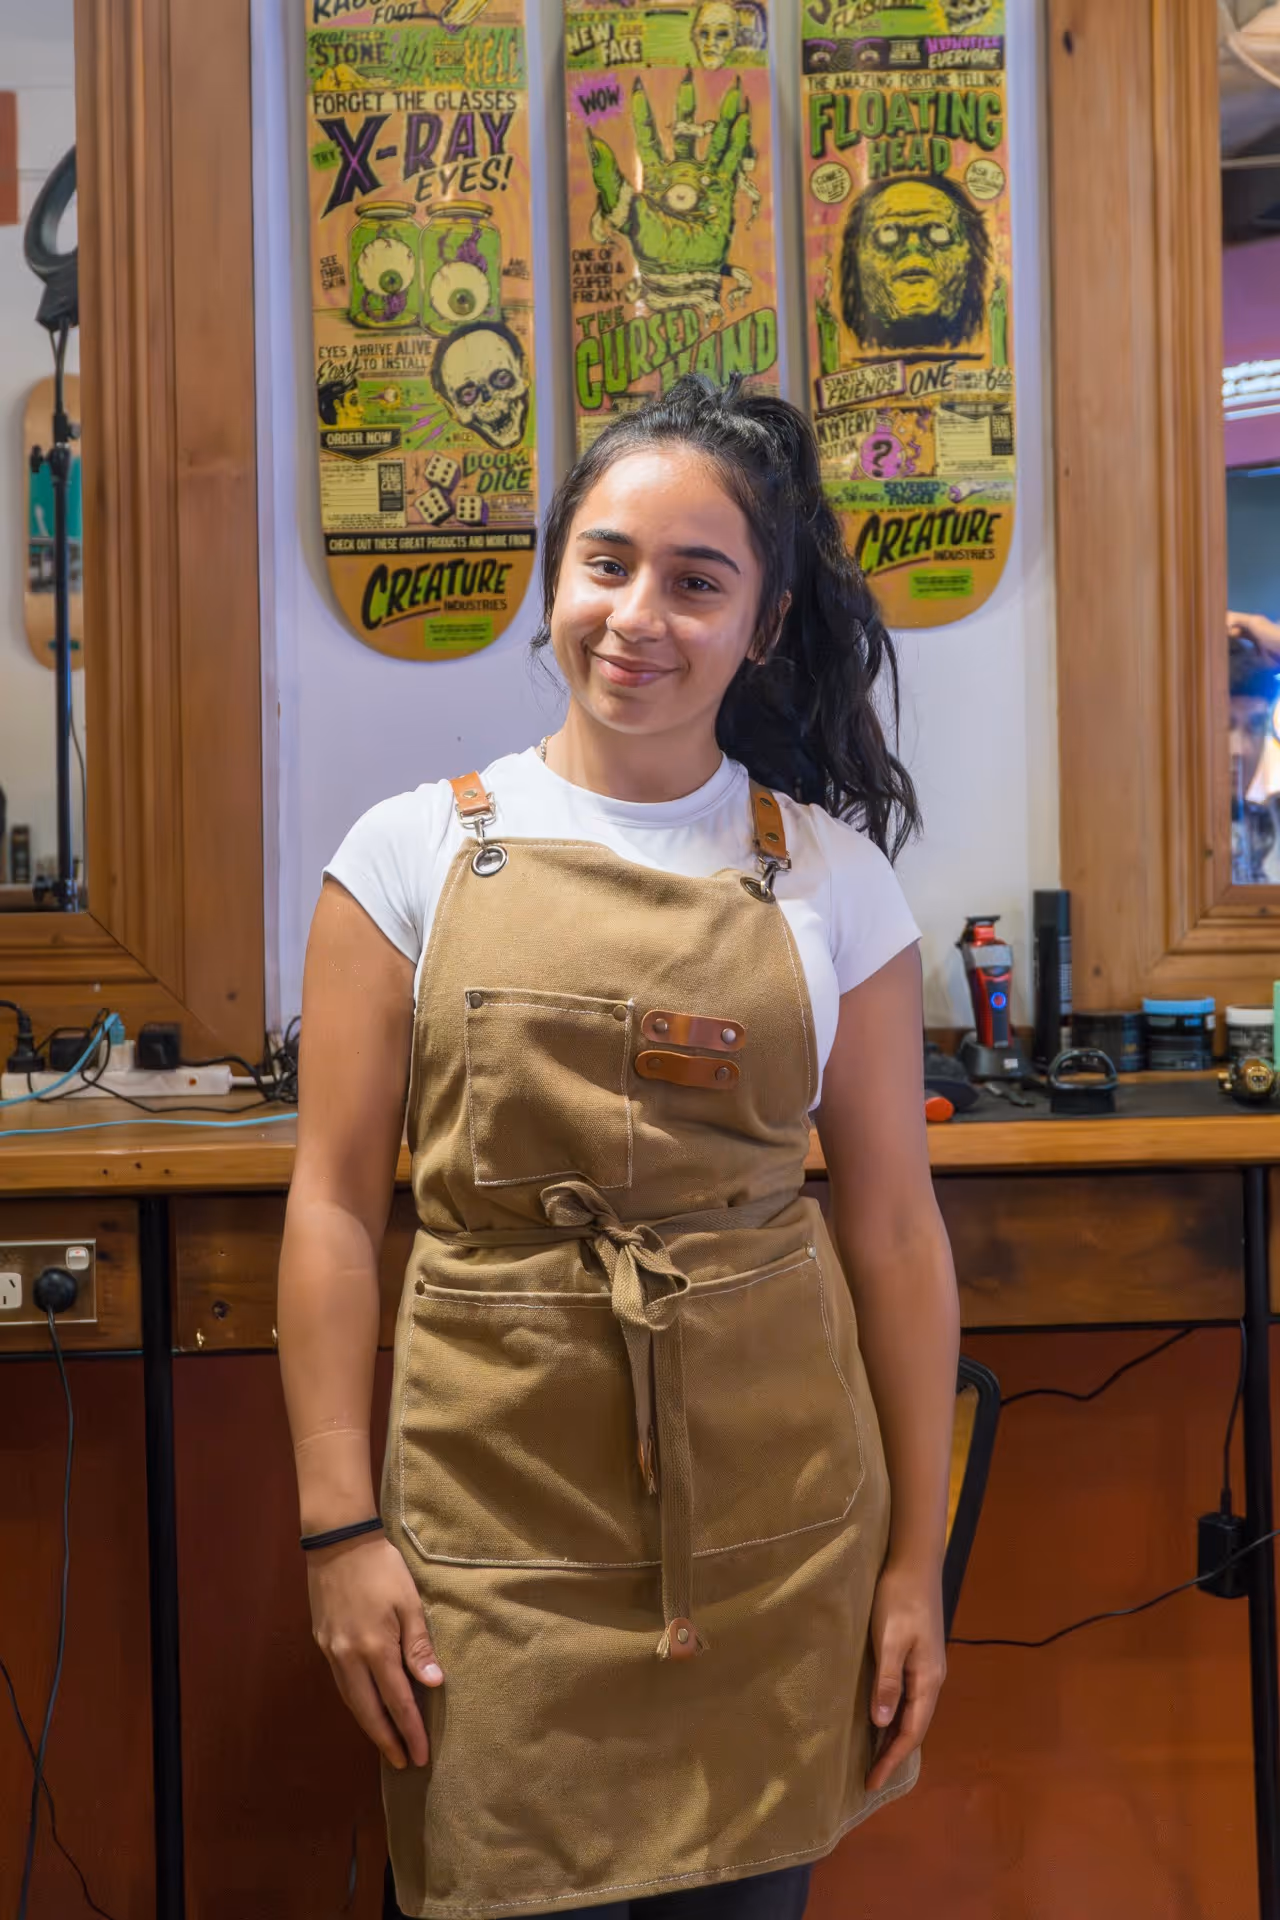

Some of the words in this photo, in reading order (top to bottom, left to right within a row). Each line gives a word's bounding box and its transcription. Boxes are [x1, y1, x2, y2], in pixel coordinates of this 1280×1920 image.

[372, 1, 418, 24] FOOT
[566, 22, 613, 55] NEW
[601, 38, 642, 66] FACE
[463, 35, 519, 85] HELL
[808, 75, 828, 91] THE
[835, 73, 893, 90] AMAZING
[313, 92, 385, 114] FORGET
[394, 92, 425, 112] THE
[434, 91, 518, 111] GLASSES
[578, 86, 620, 116] WOW
[808, 88, 1004, 159] FLOATING
[315, 111, 515, 219] X-RAY
[867, 135, 952, 180] HEAD
[413, 155, 514, 203] EYES!
[575, 305, 625, 336] THE
[318, 345, 348, 359] EYES
[352, 343, 394, 357] ARRIVE
[395, 340, 432, 356] ALIVE
[362, 358, 378, 370] TO
[382, 356, 428, 369] INSTALL
[575, 308, 701, 411] CURSED
[828, 375, 898, 406] FRIENDS
[909, 360, 957, 396] ONE
[326, 431, 364, 446] ORDER
[366, 430, 393, 444] NOW
[477, 468, 532, 494] DICE
[853, 507, 1002, 577] CREATURE
[933, 549, 996, 562] INDUSTRIES
[361, 557, 513, 631] CREATURE
[443, 598, 508, 613] INDUSTRIES
